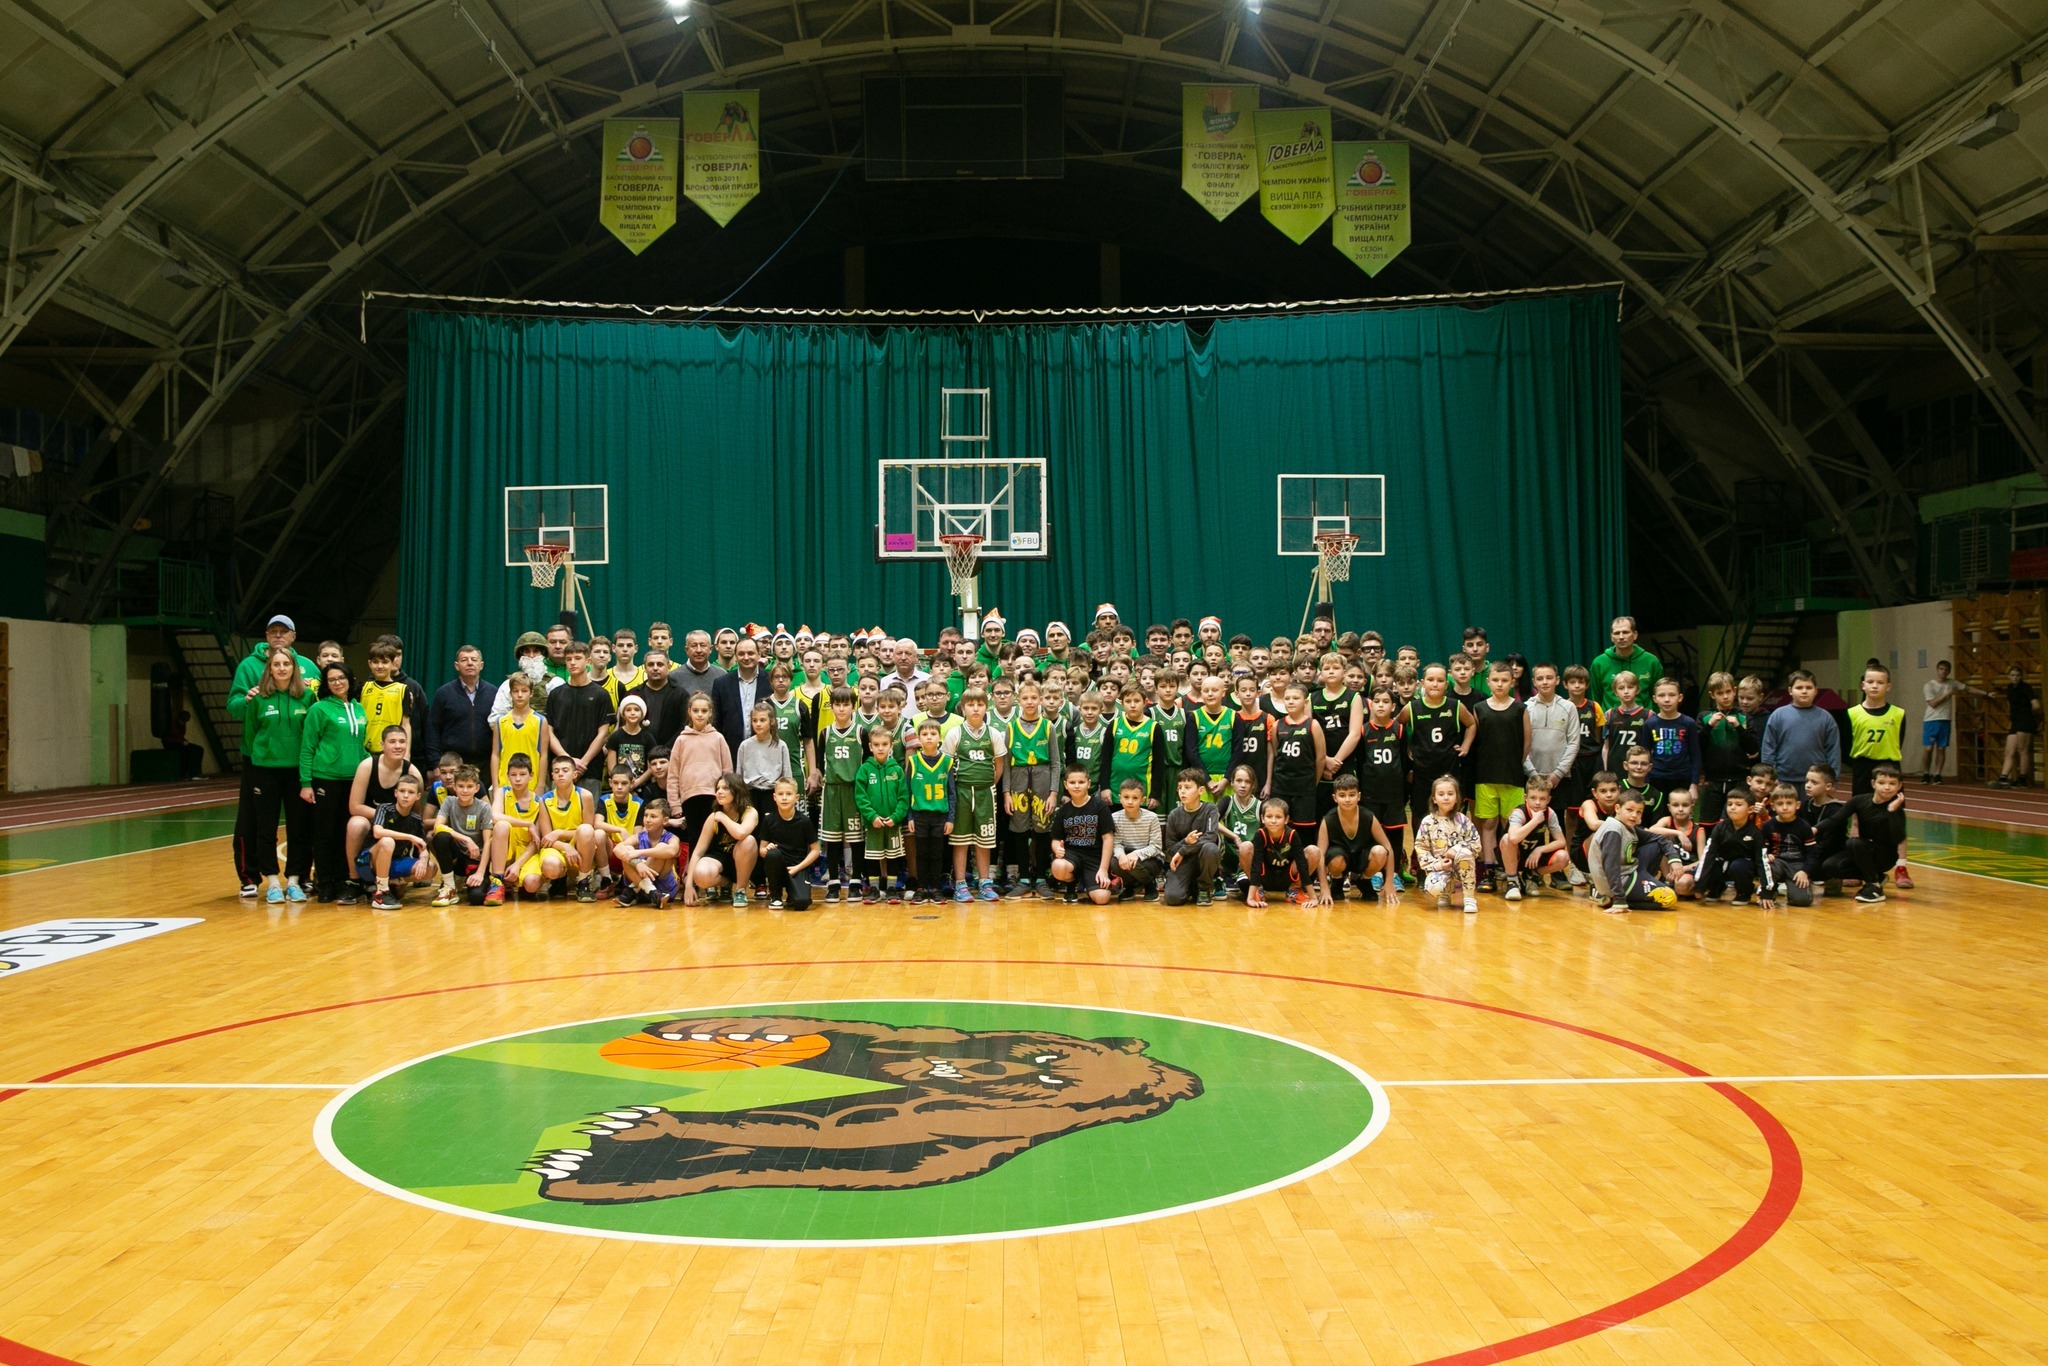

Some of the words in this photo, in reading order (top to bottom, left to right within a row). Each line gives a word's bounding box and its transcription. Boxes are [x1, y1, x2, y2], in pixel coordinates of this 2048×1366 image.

[1267, 138, 1324, 163] ГОВЕРЛА
[1262, 178, 1297, 186] ЧЕМПІОН
[1298, 176, 1331, 184] УКРАЇНИ
[1270, 192, 1299, 202] ВИЩА
[1302, 190, 1323, 200] ЛІГА
[1336, 203, 1373, 212] СРІБНИЙ
[1374, 203, 1407, 211] ПРИЗЕР
[1344, 214, 1399, 222] ЧЕМПІОНАТУ
[1354, 222, 1390, 231] УКРАЇНИ
[1349, 235, 1375, 243] ВИЩА
[1360, 245, 1383, 253] СЕЗОН
[375, 702, 383, 716] 9
[1325, 714, 1342, 729] 21
[1165, 729, 1178, 742] 16
[1205, 733, 1223, 748] 14
[1431, 727, 1443, 743] 6
[1618, 730, 1637, 746] 72
[1652, 727, 1686, 742] LITTLE
[1867, 729, 1885, 743] 27
[834, 746, 850, 759] 55
[1077, 746, 1092, 759] 68
[1119, 738, 1138, 754] 20
[1282, 741, 1300, 757] 46
[1373, 748, 1392, 764] 50
[924, 784, 944, 800] 15
[848, 818, 861, 830] 55
[980, 824, 995, 837] 88
[1233, 821, 1247, 835] 23
